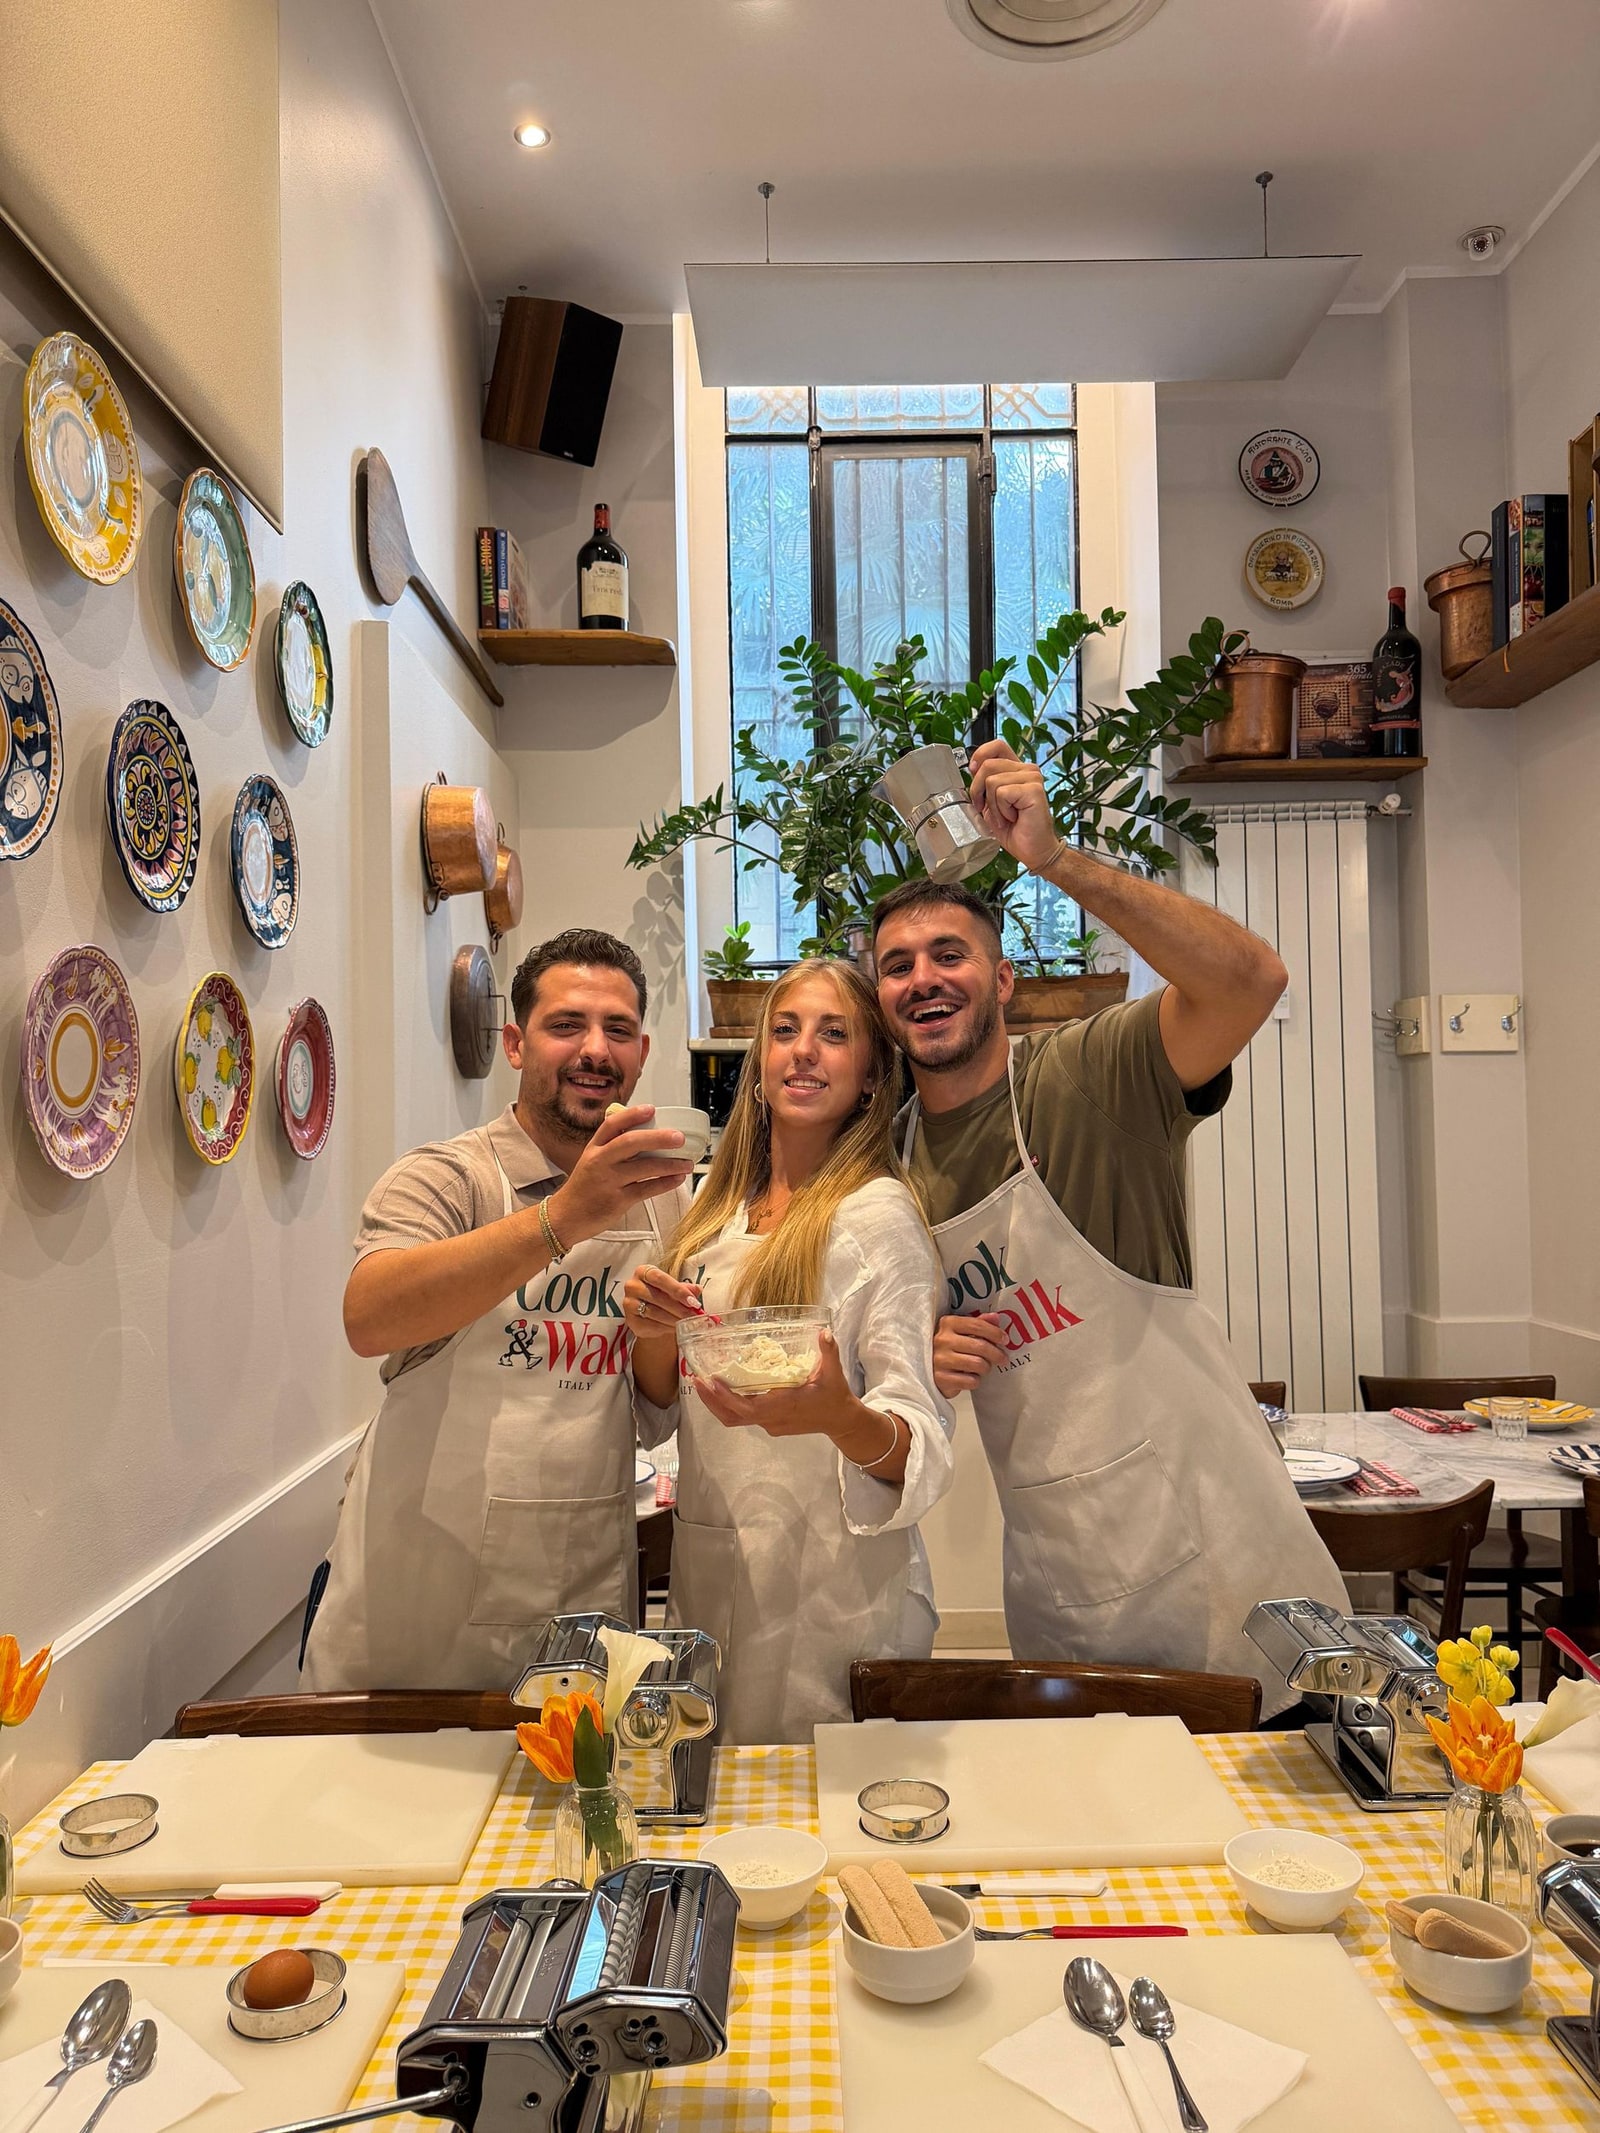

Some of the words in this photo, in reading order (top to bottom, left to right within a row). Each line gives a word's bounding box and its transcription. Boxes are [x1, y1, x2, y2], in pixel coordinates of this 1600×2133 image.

[1247, 436, 1292, 455] RISTORANTE
[1347, 664, 1367, 674] 365
[998, 1279, 1086, 1351] alk
[558, 1379, 594, 1391] ITALY
